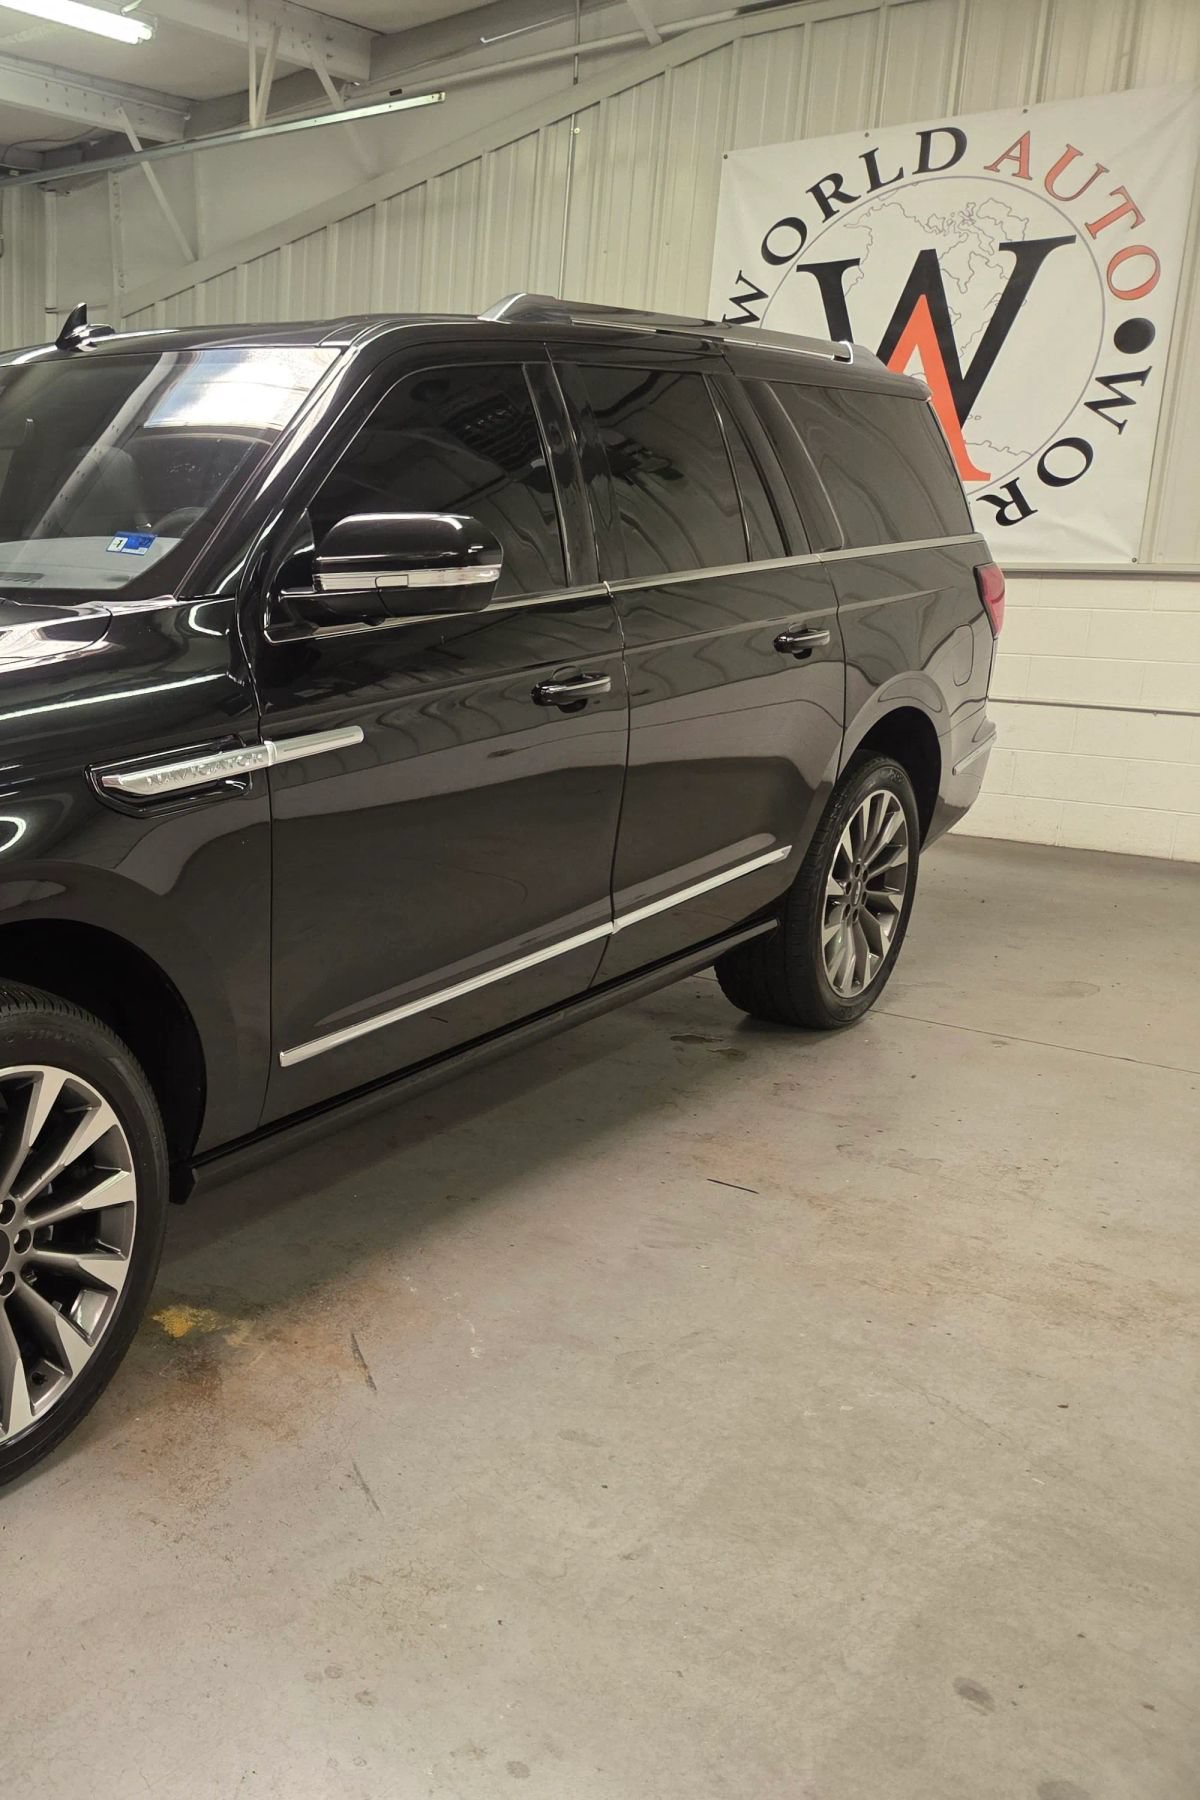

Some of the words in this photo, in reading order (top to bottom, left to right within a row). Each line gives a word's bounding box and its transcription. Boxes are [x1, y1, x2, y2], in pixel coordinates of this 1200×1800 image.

[721, 126, 968, 325] WORLD
[984, 130, 1161, 300] AUTO
[977, 365, 1153, 527] WOR
[145, 752, 264, 788] NAVIGATOR
